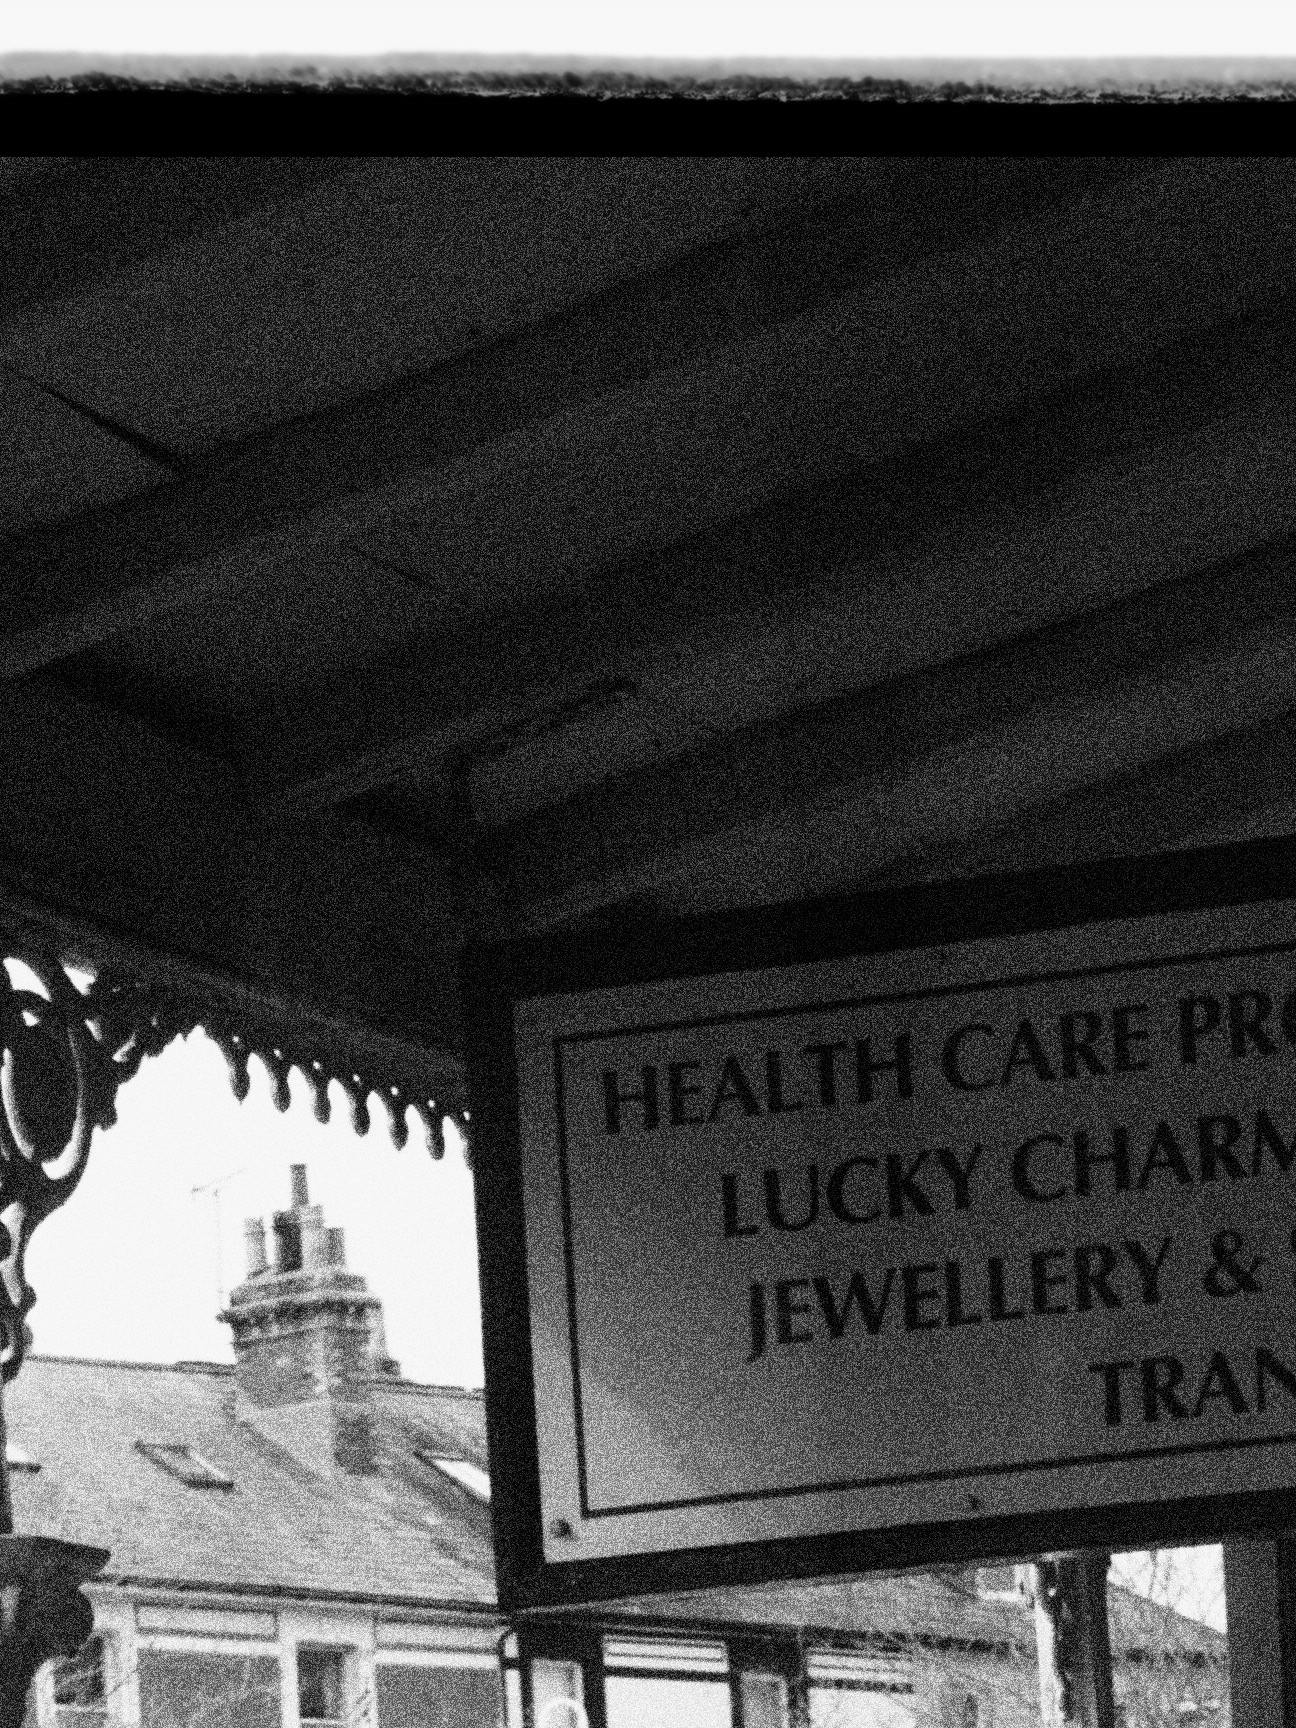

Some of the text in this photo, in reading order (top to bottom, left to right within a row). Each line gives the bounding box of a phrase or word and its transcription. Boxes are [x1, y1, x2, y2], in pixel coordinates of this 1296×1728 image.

[602, 1030, 916, 1135] HEALTH
[940, 1003, 1152, 1093] CARE
[719, 1142, 985, 1239] LUCKY
[745, 1235, 1174, 1364] JEWELLERY
[1202, 1227, 1265, 1298] &
